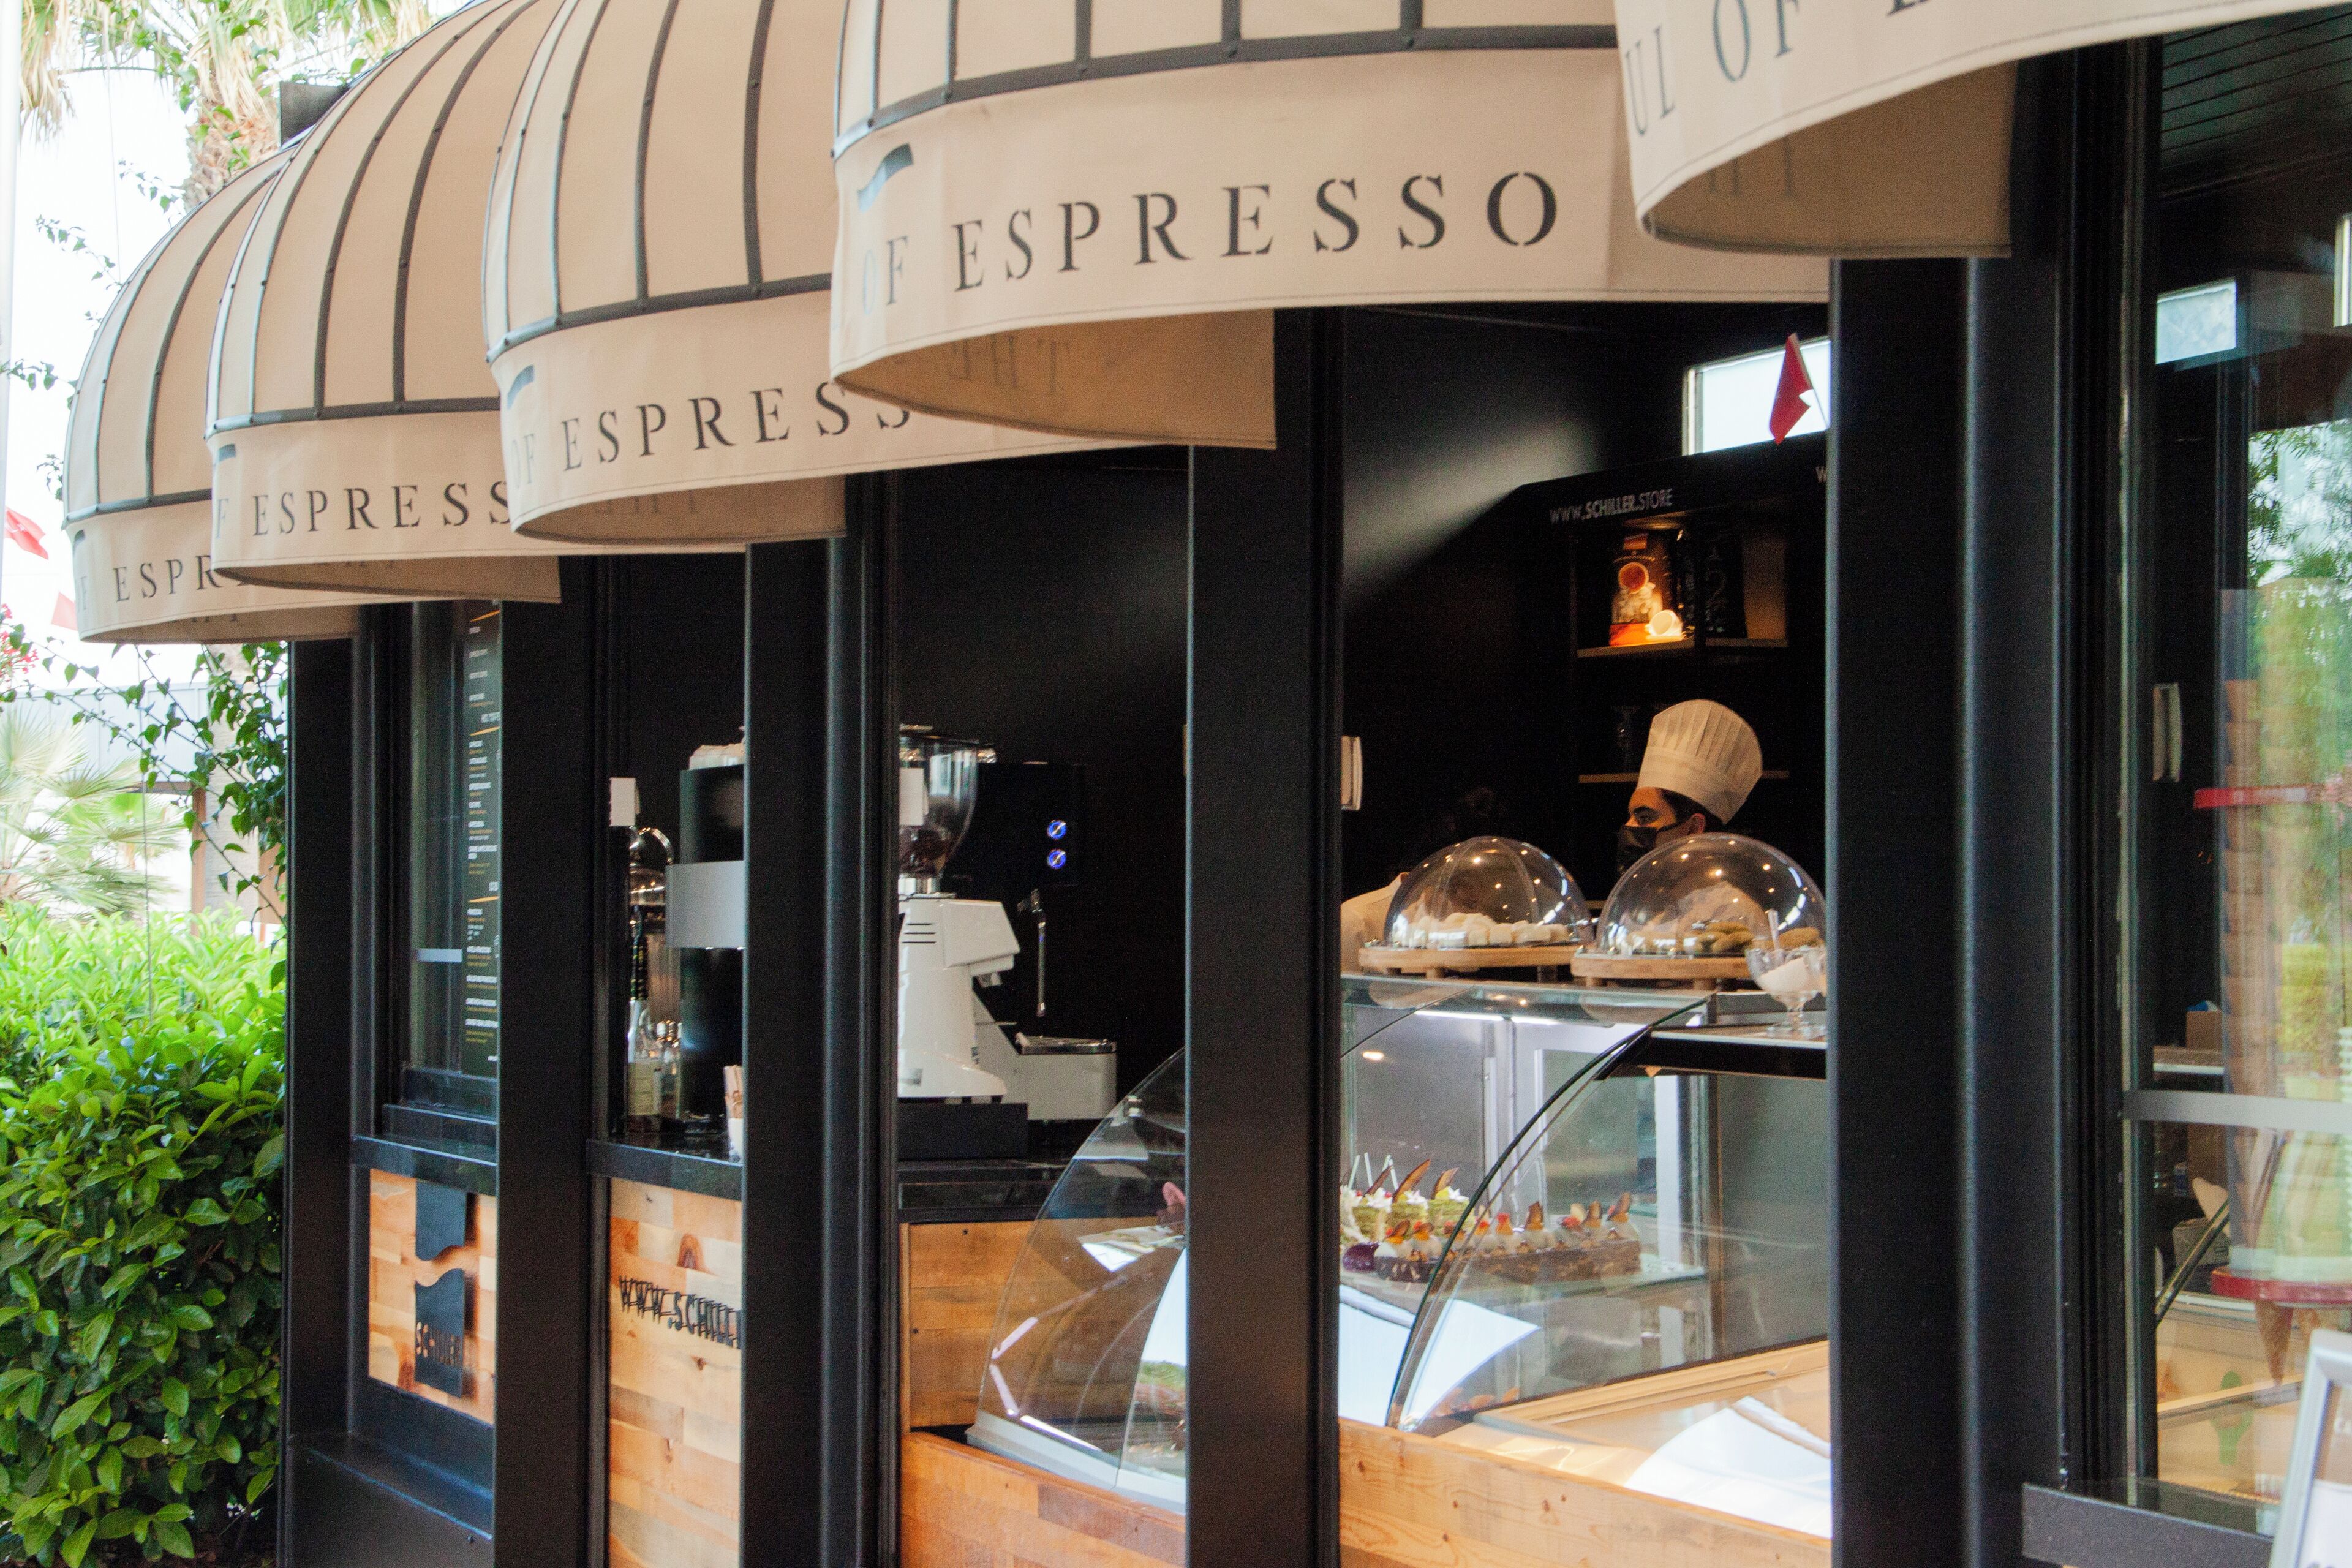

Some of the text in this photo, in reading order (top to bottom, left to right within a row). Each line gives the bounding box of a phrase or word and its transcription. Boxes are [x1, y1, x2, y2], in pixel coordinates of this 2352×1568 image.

[861, 172, 1558, 316] OF ESPRESSO
[560, 380, 910, 472] ESPRES
[112, 554, 247, 603] ESPR
[619, 1274, 741, 1349] WWW.SCHILL
